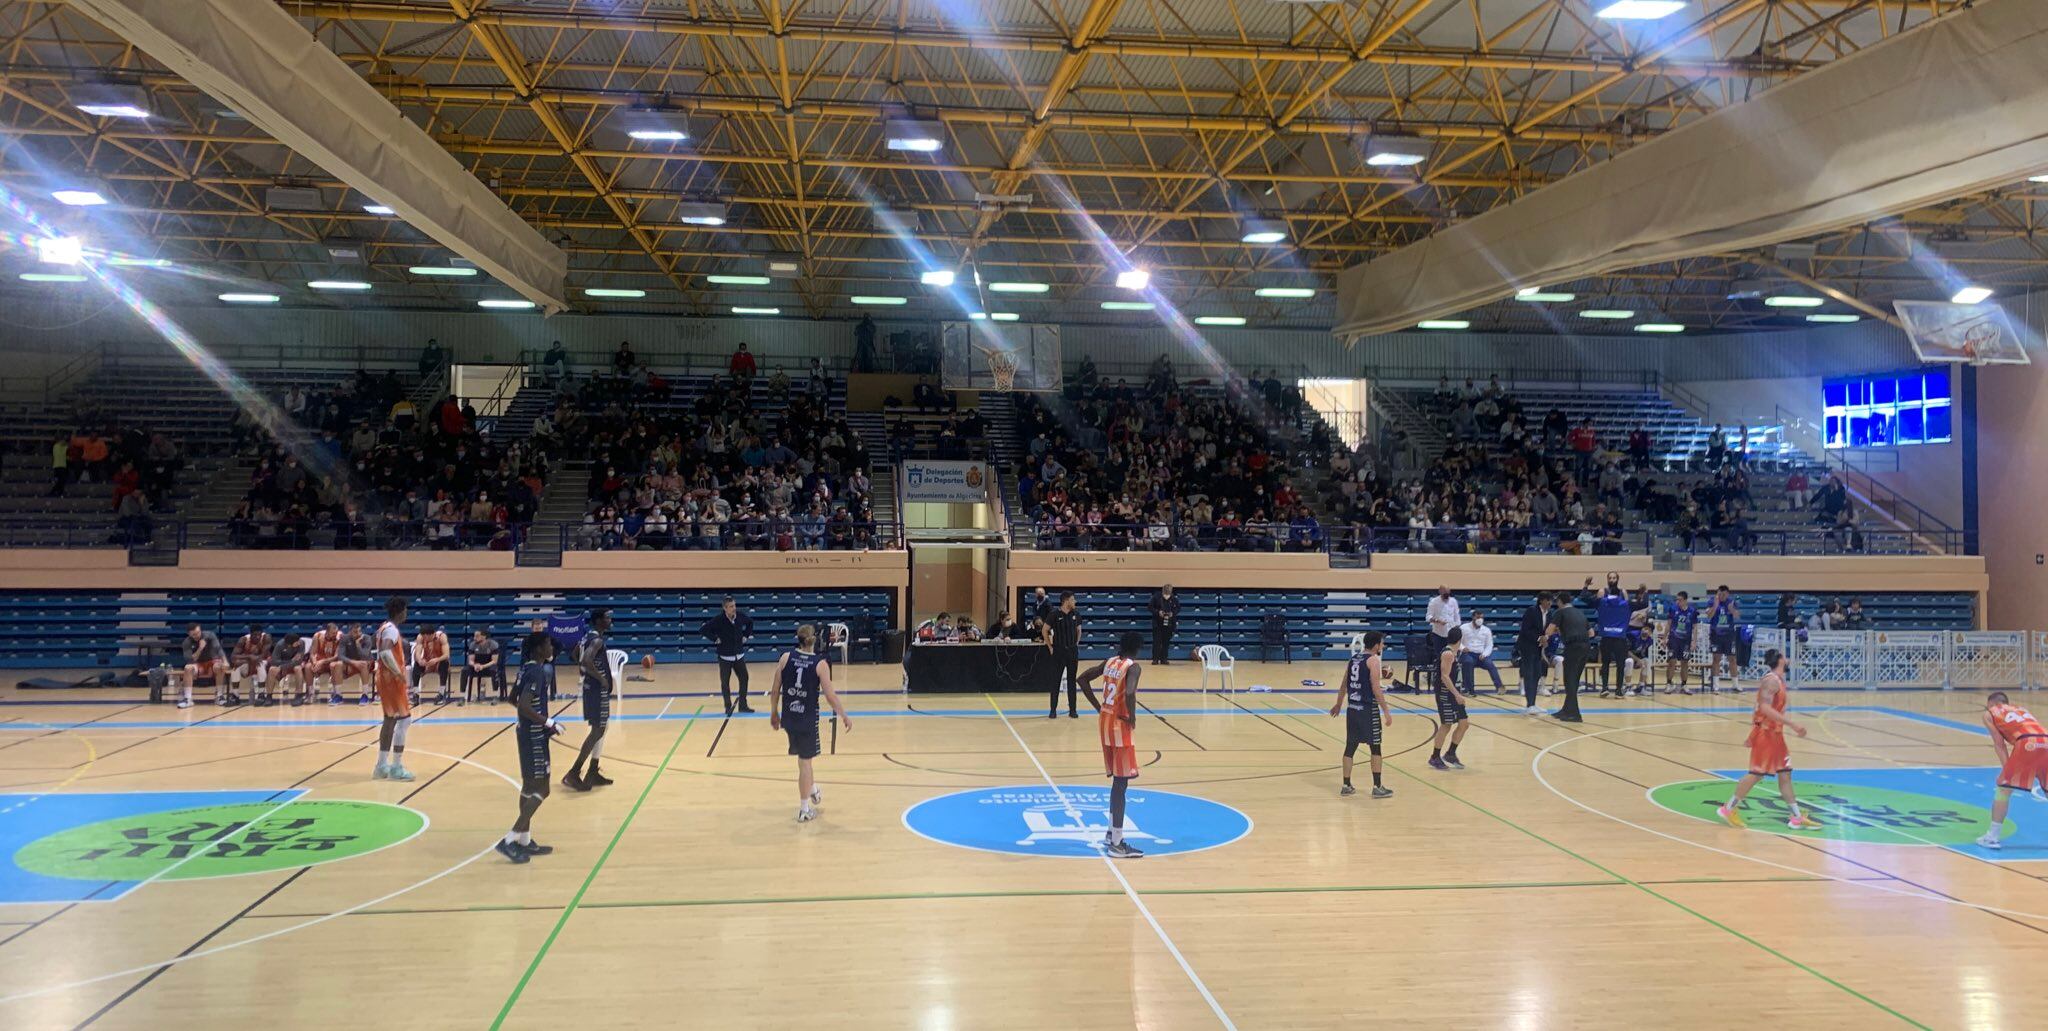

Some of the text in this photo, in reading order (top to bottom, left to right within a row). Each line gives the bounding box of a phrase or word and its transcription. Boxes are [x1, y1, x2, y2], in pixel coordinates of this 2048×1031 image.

[926, 468, 962, 476] Delegación
[553, 625, 579, 634] molten
[795, 667, 803, 688] 1
[1350, 664, 1360, 681] 9
